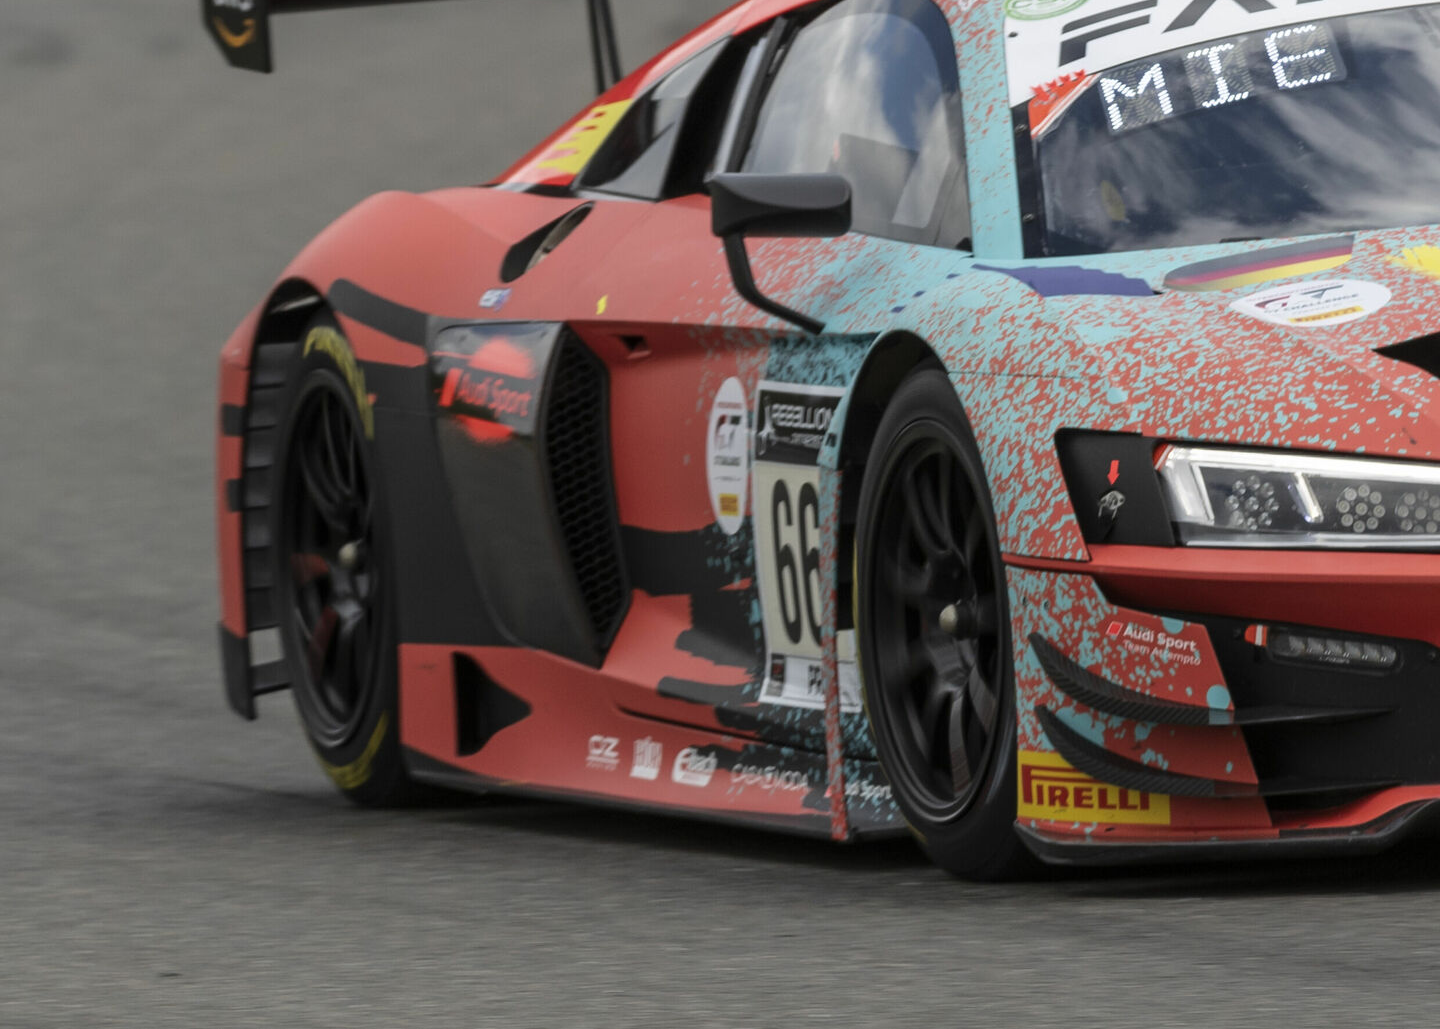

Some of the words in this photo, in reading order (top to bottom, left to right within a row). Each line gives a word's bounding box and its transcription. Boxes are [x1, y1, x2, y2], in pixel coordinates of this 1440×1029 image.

[1100, 23, 1337, 131] MIE
[772, 479, 822, 647] 66
[1123, 625, 1154, 644] Audi
[1157, 633, 1197, 652] Sport
[1021, 764, 1150, 811] PIRELLI
